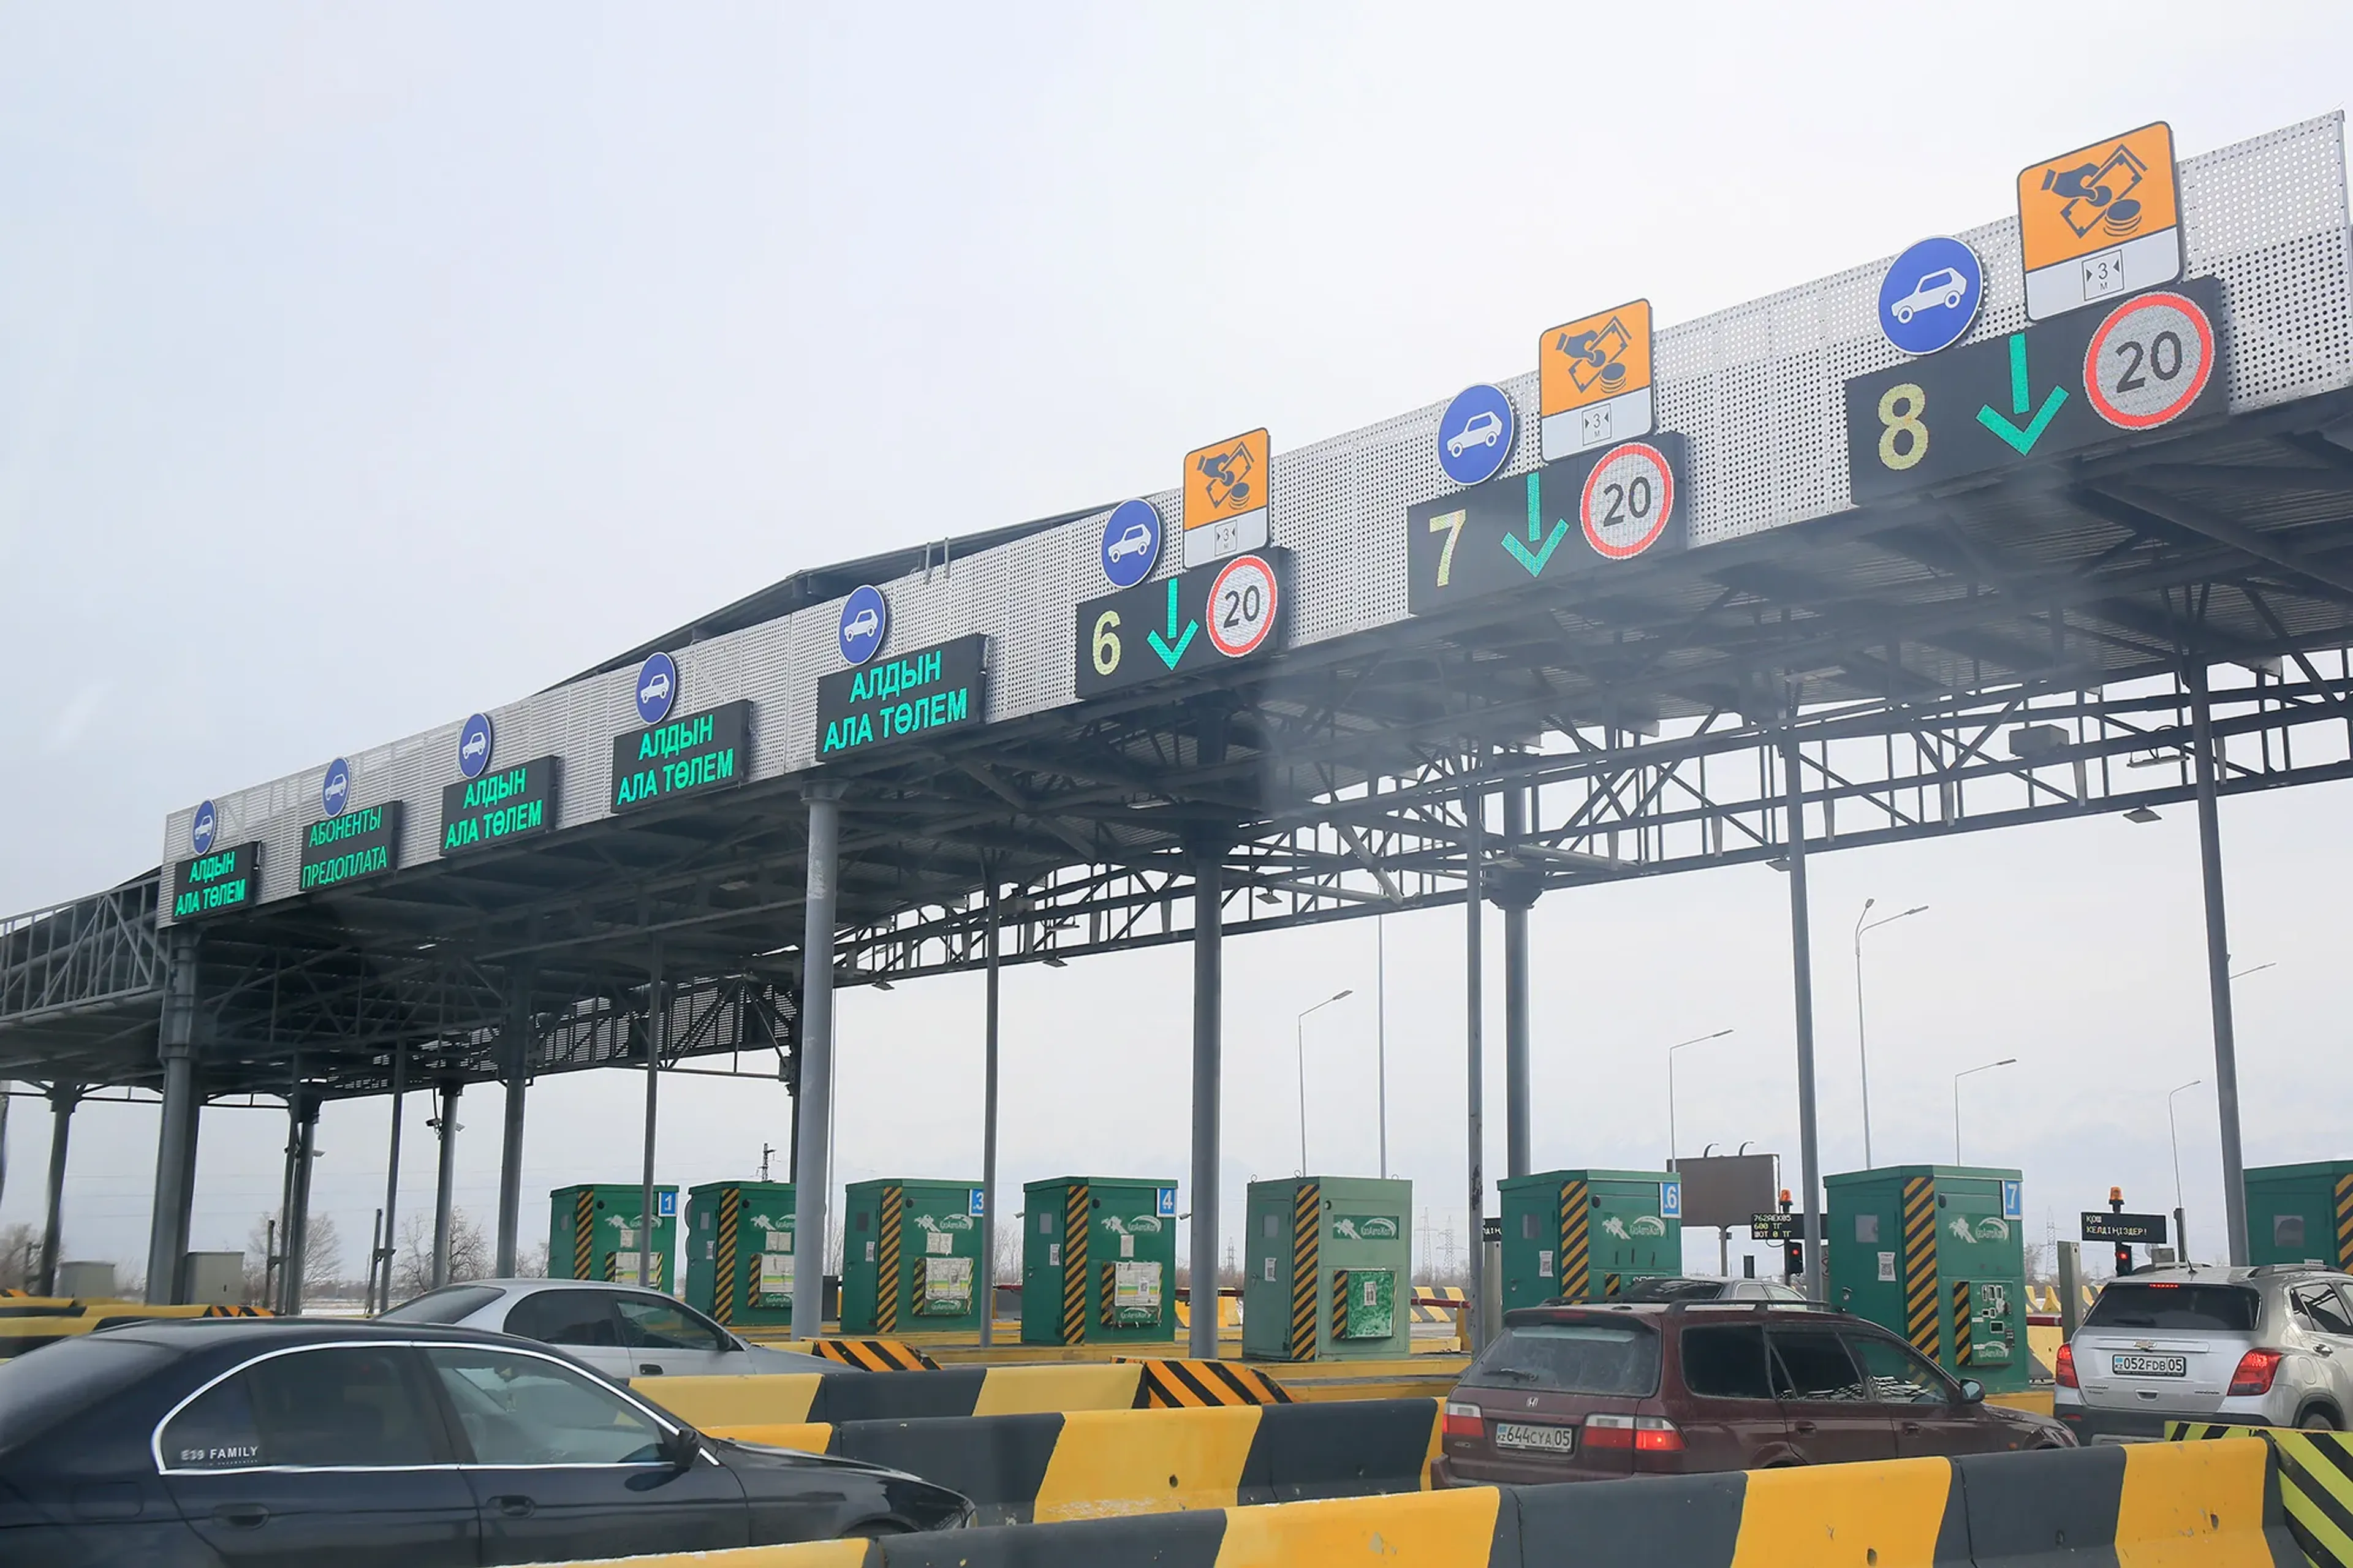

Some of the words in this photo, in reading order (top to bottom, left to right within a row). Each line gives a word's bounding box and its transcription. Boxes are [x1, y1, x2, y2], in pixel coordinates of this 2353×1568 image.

[2097, 262, 2108, 279] 3
[2115, 330, 2183, 393] 20
[1593, 412, 1601, 428] 3
[1877, 382, 1929, 471] 8
[1603, 476, 1651, 527] 20
[1223, 528, 1229, 542] 3
[1430, 509, 1466, 587] 7
[1223, 585, 1260, 629] 20
[1093, 610, 1121, 675] 6
[849, 650, 941, 703] АЛДЫН
[638, 714, 713, 760] АЛДЫН
[822, 713, 874, 753] АЛА
[880, 687, 968, 738] ТӨЛЕМ
[463, 768, 526, 809] АЛДЫН
[616, 769, 658, 806] АЛА
[663, 748, 733, 792] ТӨЛЕМ
[309, 806, 382, 847] АБОНЕНТЫ
[444, 818, 480, 849] АЛА
[483, 799, 542, 838] ТӨЛЕМ
[189, 852, 235, 883] АЛДЫН
[302, 846, 387, 888] ПРЕДОПЛАТА
[175, 891, 200, 917] АЛА
[203, 879, 245, 909] ТӨЛЕМ
[664, 1194, 672, 1211] 1
[976, 1192, 983, 1210] 3
[1162, 1190, 1173, 1210] 4
[1667, 1186, 1678, 1209] 6
[2007, 1184, 2018, 1209] 7
[2168, 1358, 2183, 1371] 05
[210, 1445, 258, 1460] FAMILY
[1555, 1430, 1571, 1447] 05
